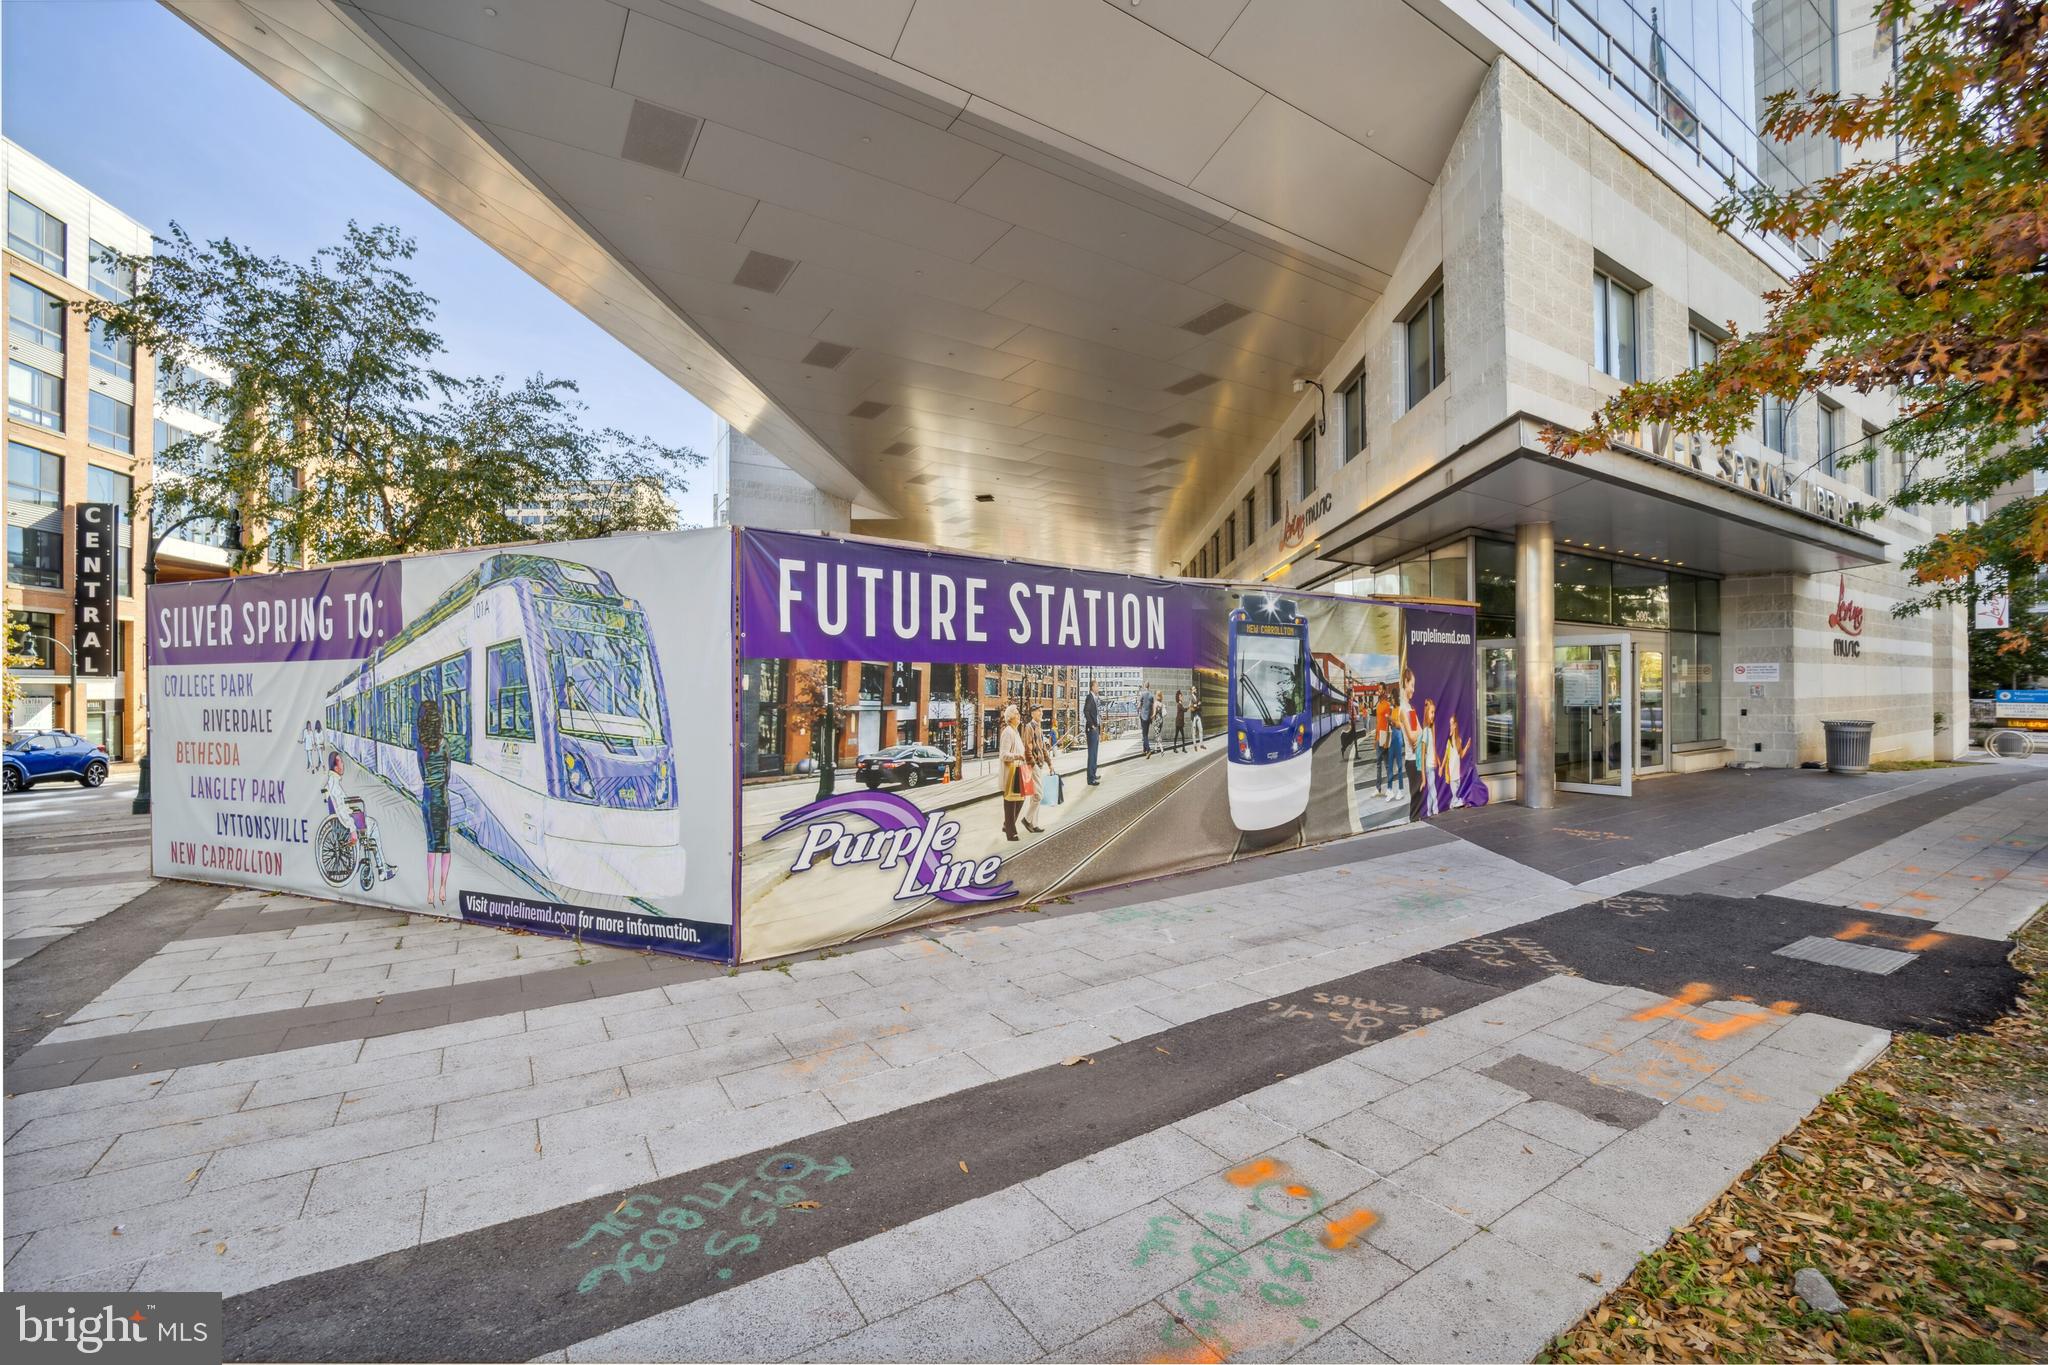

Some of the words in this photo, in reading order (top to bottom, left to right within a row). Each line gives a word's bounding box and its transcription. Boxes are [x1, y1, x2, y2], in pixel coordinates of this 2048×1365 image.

[83, 506, 101, 673] CENTRAL
[778, 557, 988, 643] FUTURE
[1008, 581, 1166, 650] STATION
[159, 603, 232, 649] SILVER
[242, 596, 333, 645] SPRING
[344, 592, 384, 639] TO:
[1411, 628, 1471, 645] purplelinemd.com
[164, 675, 216, 698] COLLEGE
[221, 673, 254, 697] PARK
[203, 708, 273, 733] RIVERDALE
[176, 740, 240, 766] BETHESDA
[190, 776, 246, 802] LANGLEY
[252, 779, 285, 805] PARK
[216, 811, 309, 844] LYTTONSVILLE
[791, 811, 961, 873] Purple
[171, 841, 196, 866] NEW
[201, 845, 283, 876] CARROLLTON
[894, 848, 1002, 900] Line
[466, 895, 488, 913] Visit
[489, 900, 576, 926] purplelinemd.com
[578, 910, 593, 929] for
[596, 917, 624, 934] more
[626, 917, 701, 943] information.
